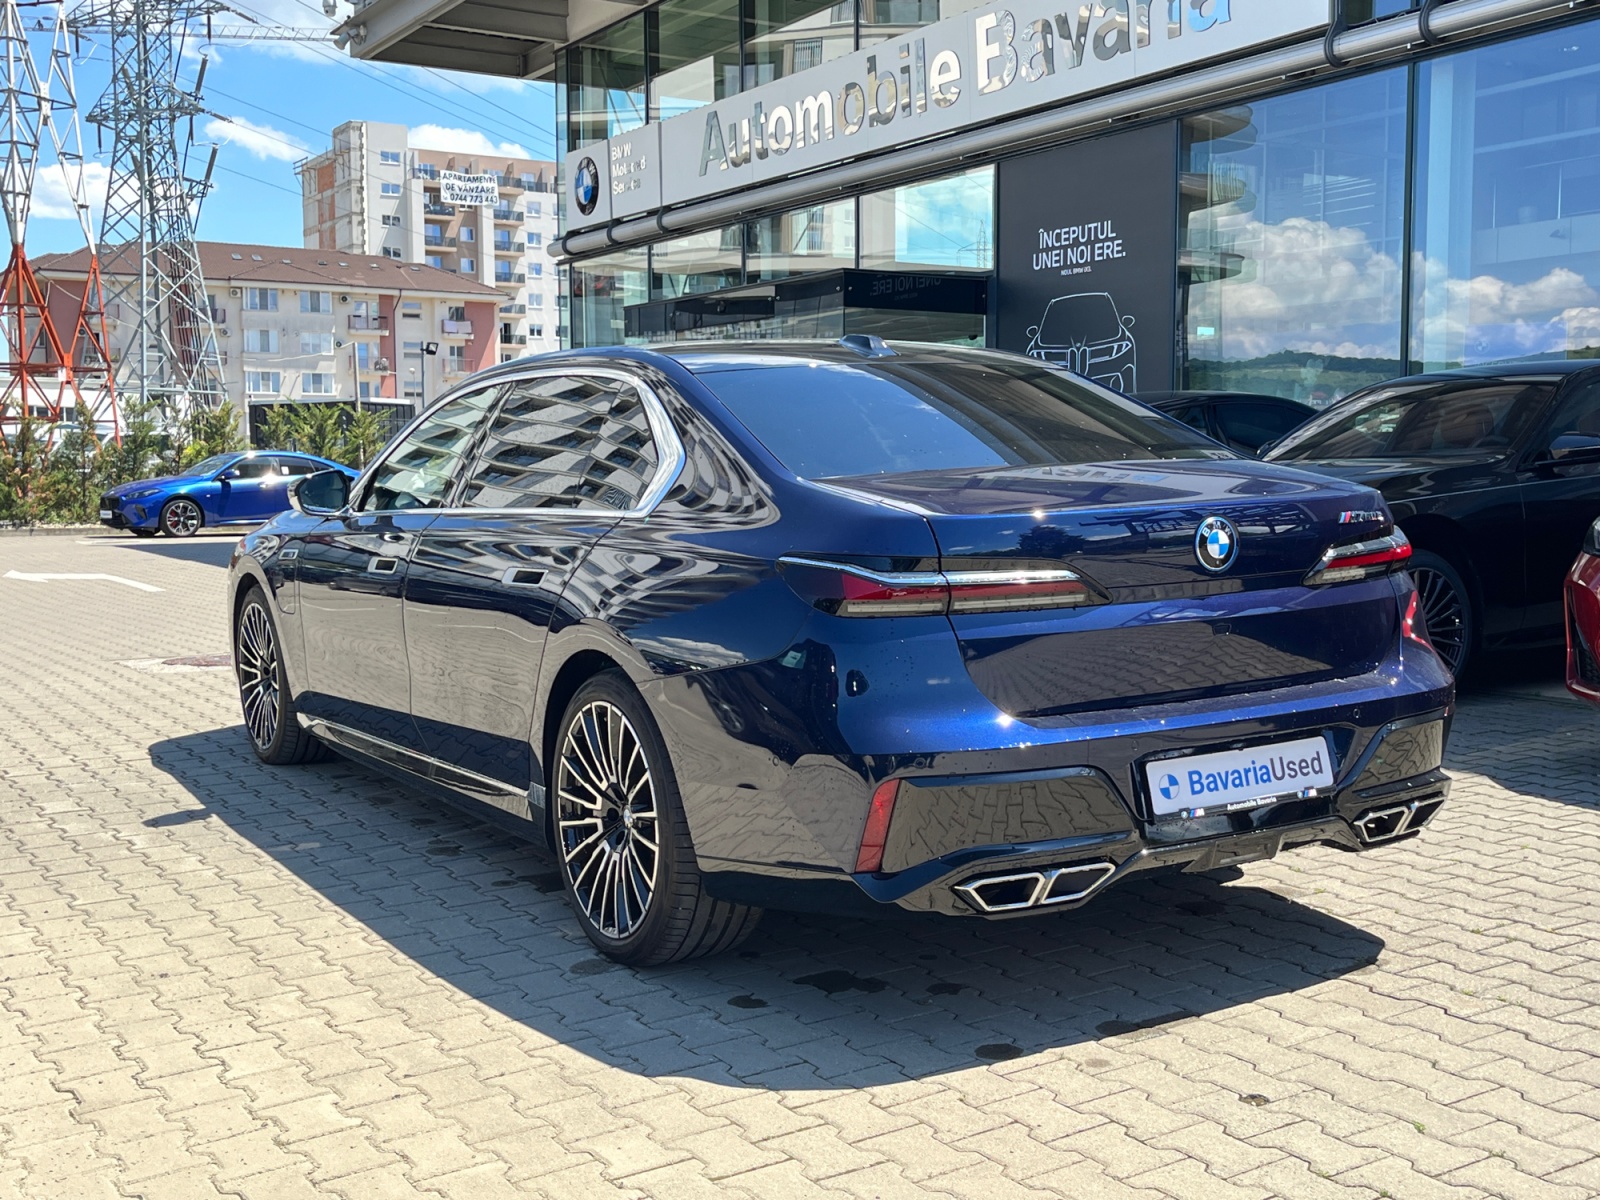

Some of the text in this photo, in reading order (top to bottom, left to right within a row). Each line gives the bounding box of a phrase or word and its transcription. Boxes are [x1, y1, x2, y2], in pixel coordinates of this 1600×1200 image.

[699, 37, 961, 177] Automobile
[611, 142, 632, 161] BMW
[612, 155, 646, 178] Motrd
[442, 172, 496, 184] APARTAMENTE
[445, 182, 456, 192] DE
[450, 192, 468, 202] 0744
[1038, 220, 1117, 249] ÎNCEPUTUL
[1032, 239, 1126, 271] UNEI NOI ERE.
[1201, 520, 1232, 538] BMW
[1187, 751, 1324, 796] BavariaUsed
[1226, 795, 1277, 811] Automobile Bavaria
